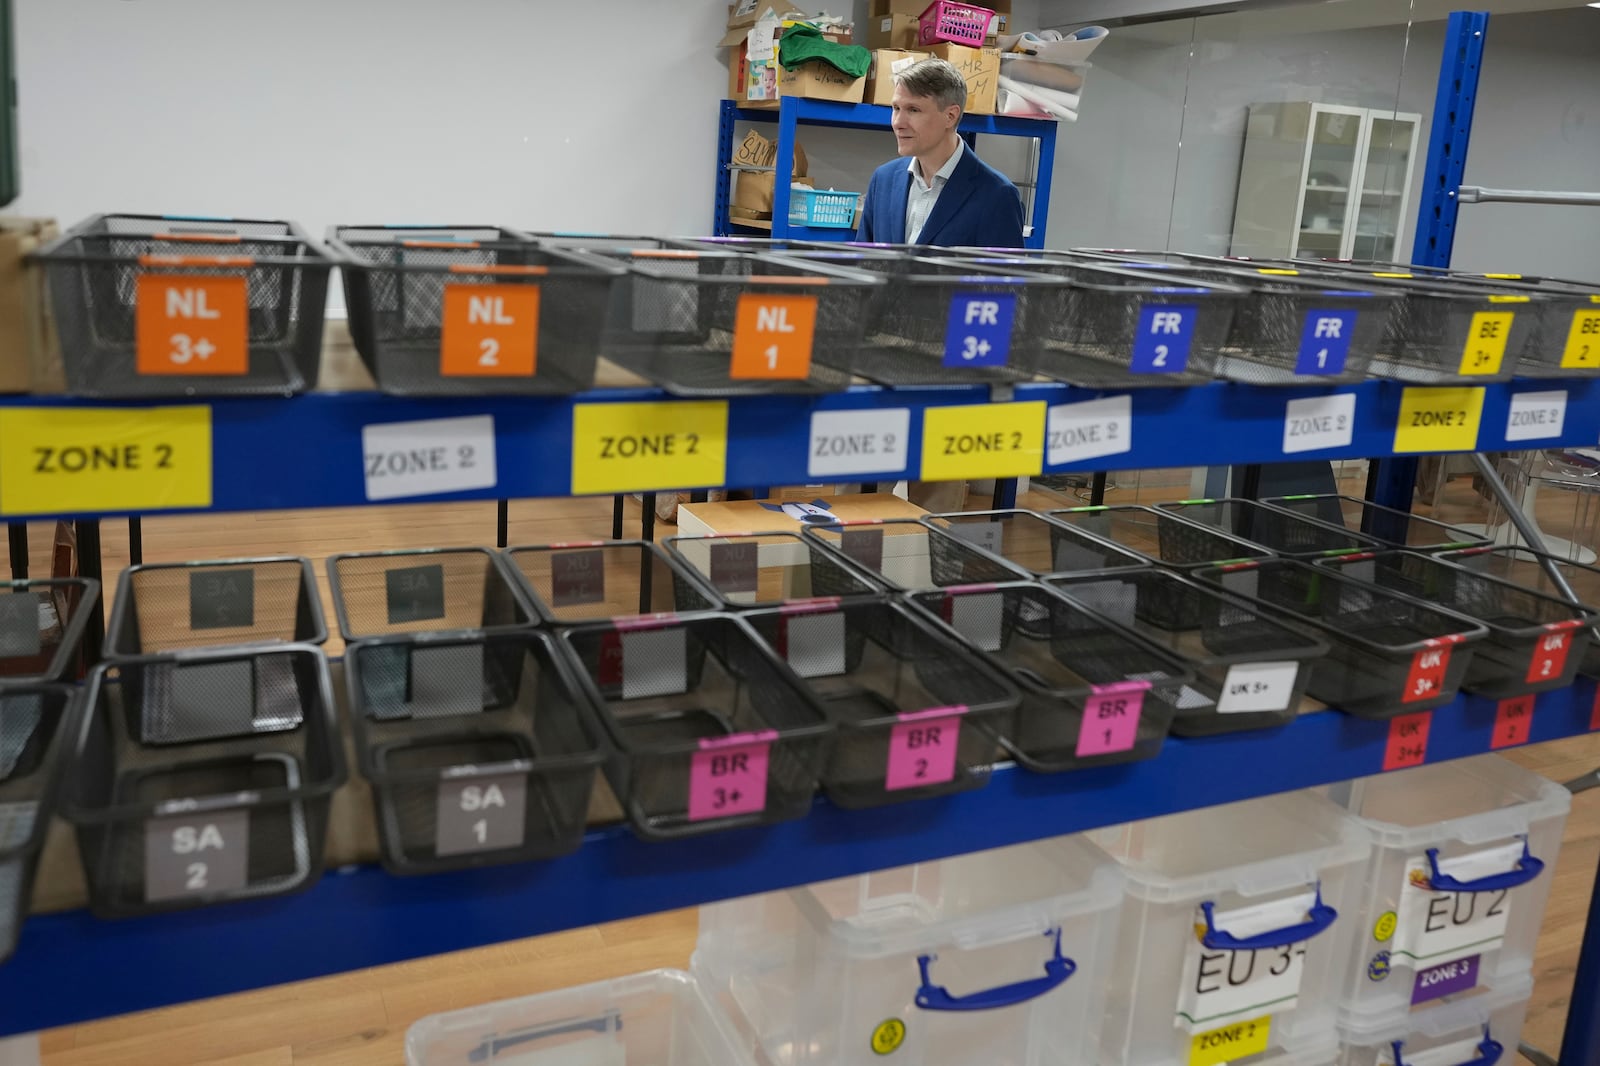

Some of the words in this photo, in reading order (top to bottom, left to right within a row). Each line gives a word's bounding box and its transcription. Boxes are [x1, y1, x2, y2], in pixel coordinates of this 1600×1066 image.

[165, 288, 220, 319] NL
[468, 296, 515, 325] NL
[964, 301, 999, 325] FR
[756, 306, 796, 333] NL
[1151, 312, 1182, 334] FR
[1314, 318, 1343, 338] FR
[1479, 321, 1501, 339] BE
[1581, 318, 1600, 334] BE
[169, 333, 217, 364] 3+
[479, 338, 500, 366] 2
[764, 345, 778, 370] 1
[961, 336, 991, 360] 3+
[1152, 345, 1169, 367] 2
[1317, 348, 1328, 368] 1
[1473, 350, 1490, 367] 3+
[1579, 345, 1589, 360] 2
[1289, 415, 1333, 437] ZONE
[1336, 414, 1347, 431] 2
[1411, 410, 1455, 427] ZONE
[1458, 410, 1467, 426] 2
[1511, 409, 1547, 427] ZONE
[1549, 408, 1559, 423] 2
[599, 435, 676, 459] ZONE
[686, 434, 699, 455] 2
[814, 434, 876, 457] ZONE
[883, 434, 896, 453] 2
[943, 433, 1003, 455] ZONE
[1010, 431, 1023, 450] 2
[1048, 424, 1101, 449] ZONE
[1107, 421, 1119, 440] 2
[34, 445, 140, 473] ZONE
[154, 444, 174, 469] 2
[366, 447, 448, 477] ZONE
[458, 445, 476, 468] 2
[1544, 634, 1565, 651] UK
[1419, 651, 1443, 669] UK
[1541, 660, 1552, 676] 2
[1230, 683, 1250, 696] UK
[1098, 700, 1127, 719] BR
[907, 727, 942, 750] BR
[1104, 729, 1112, 746] 1
[1400, 721, 1422, 737] UK
[1507, 725, 1516, 738] 2
[711, 753, 749, 777] BR
[915, 758, 928, 778] 2
[460, 783, 506, 812] SA
[713, 788, 742, 809] 3+
[172, 823, 225, 854] SA
[472, 818, 487, 844] 1
[185, 862, 208, 890] 2
[1425, 891, 1477, 933] EU
[1486, 889, 1508, 917] 2
[1196, 949, 1256, 994] EU
[1420, 964, 1459, 988] ZONE
[1460, 960, 1470, 975] 3
[1200, 1025, 1245, 1050] ZONE
[1248, 1023, 1257, 1038] 2
